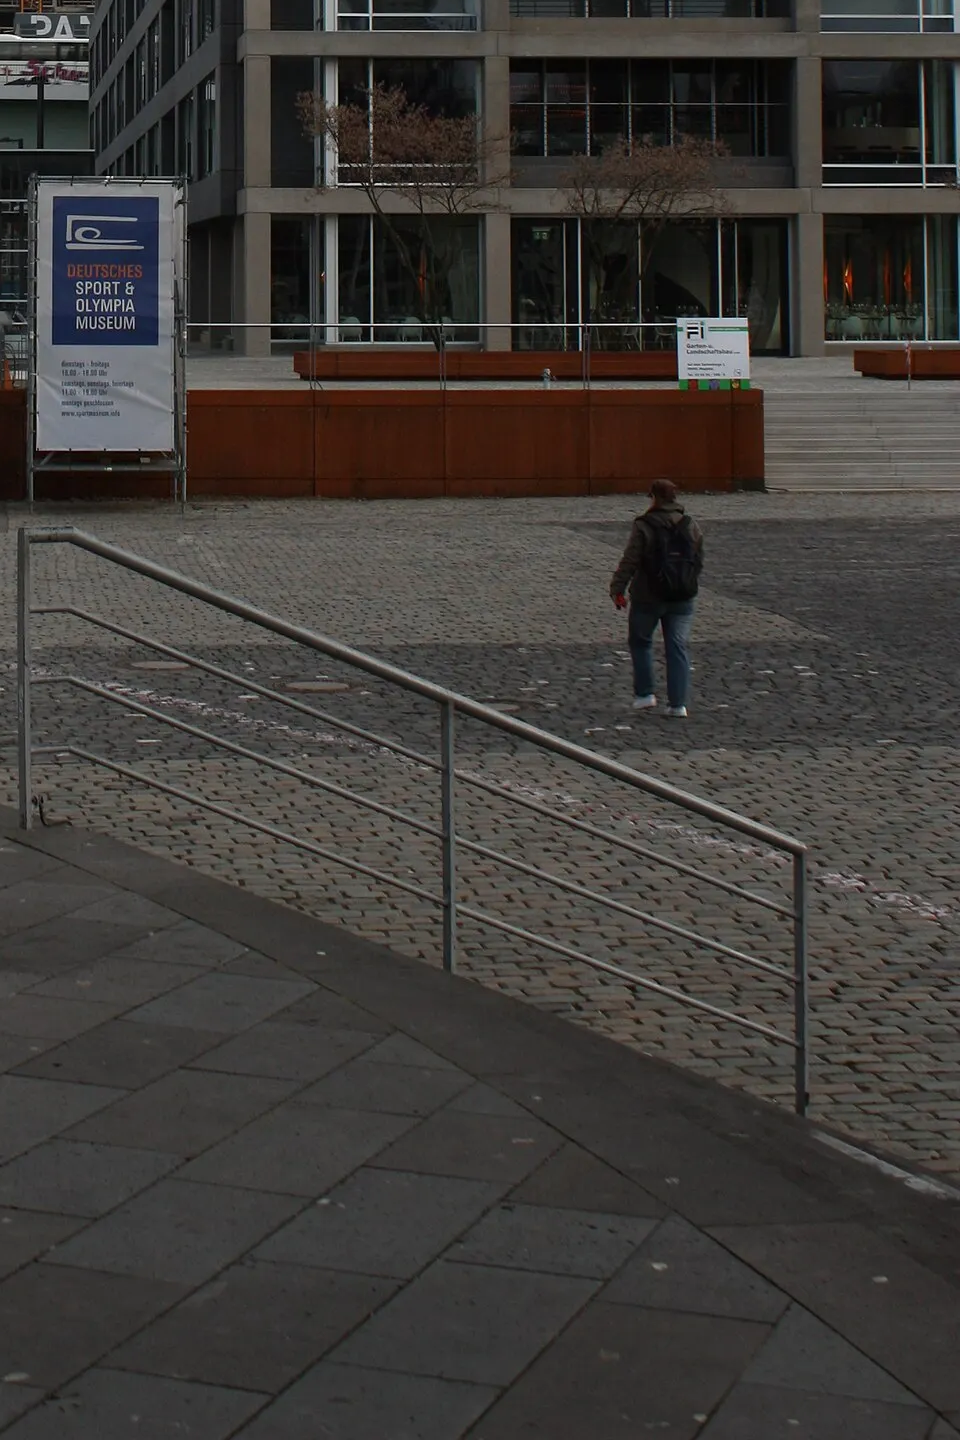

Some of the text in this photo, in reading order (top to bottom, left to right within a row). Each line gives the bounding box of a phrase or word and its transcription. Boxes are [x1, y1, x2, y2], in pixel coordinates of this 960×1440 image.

[67, 264, 143, 278] DEUTSCHES
[75, 281, 135, 295] SPORT &
[76, 298, 135, 312] OLYMPIA
[76, 316, 136, 330] MUSEUM
